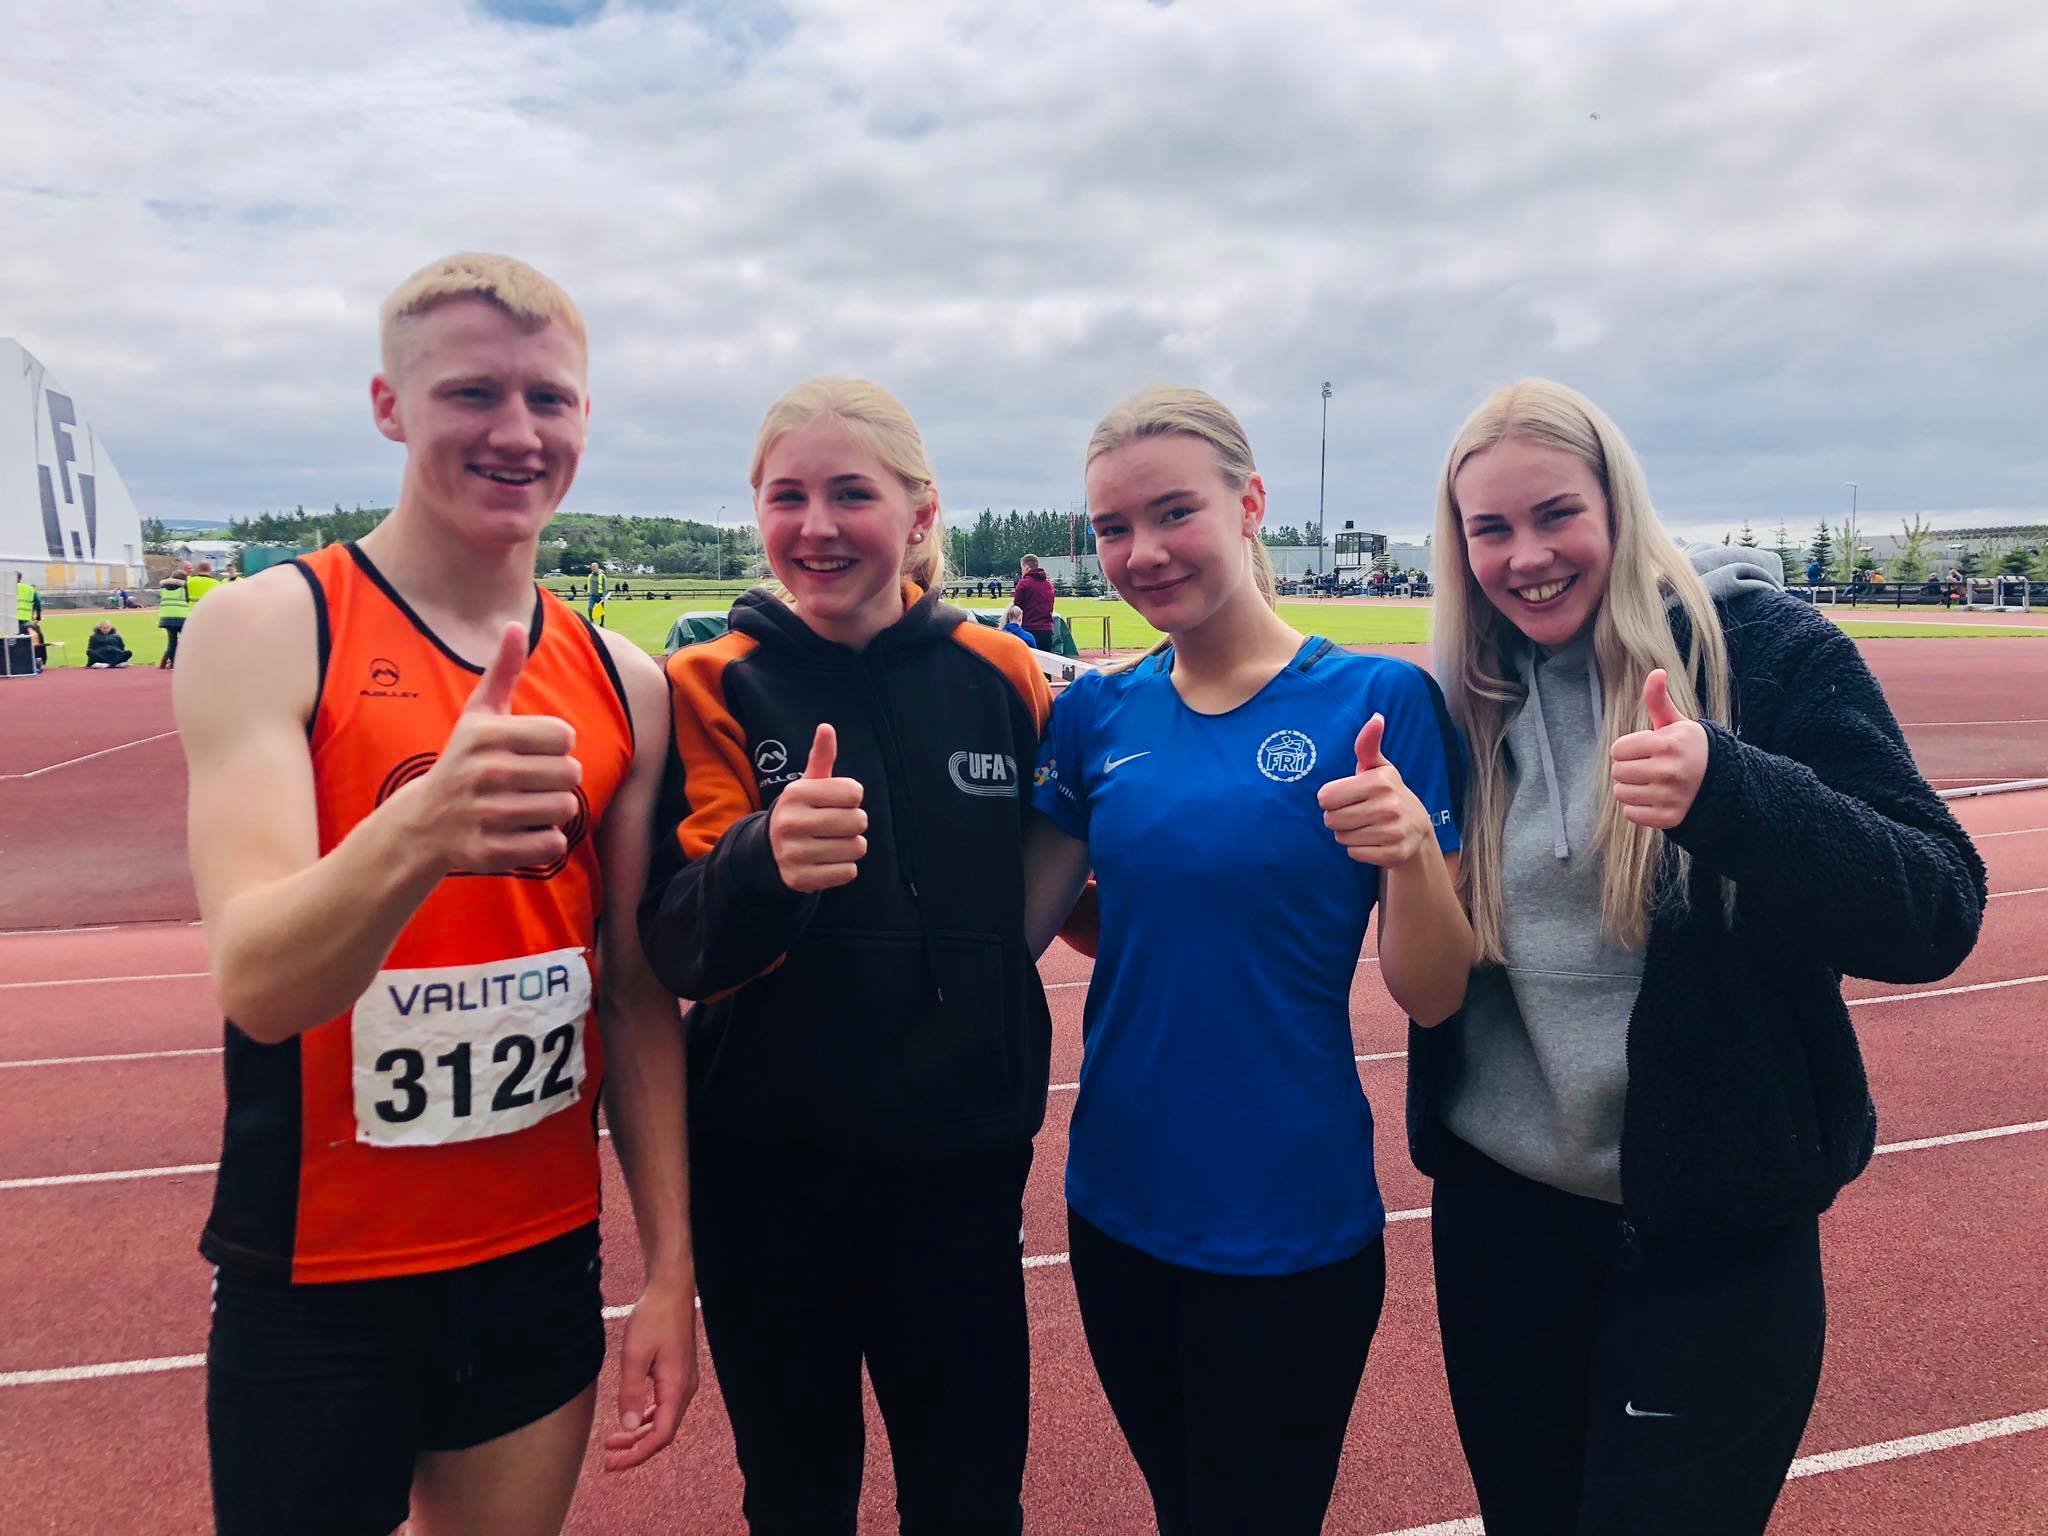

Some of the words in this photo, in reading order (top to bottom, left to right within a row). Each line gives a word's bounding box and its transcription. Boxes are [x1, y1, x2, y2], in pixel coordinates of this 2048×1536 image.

[968, 752, 1007, 780] UFA
[388, 964, 569, 1016] VALITOR
[374, 1023, 576, 1124] 3122
